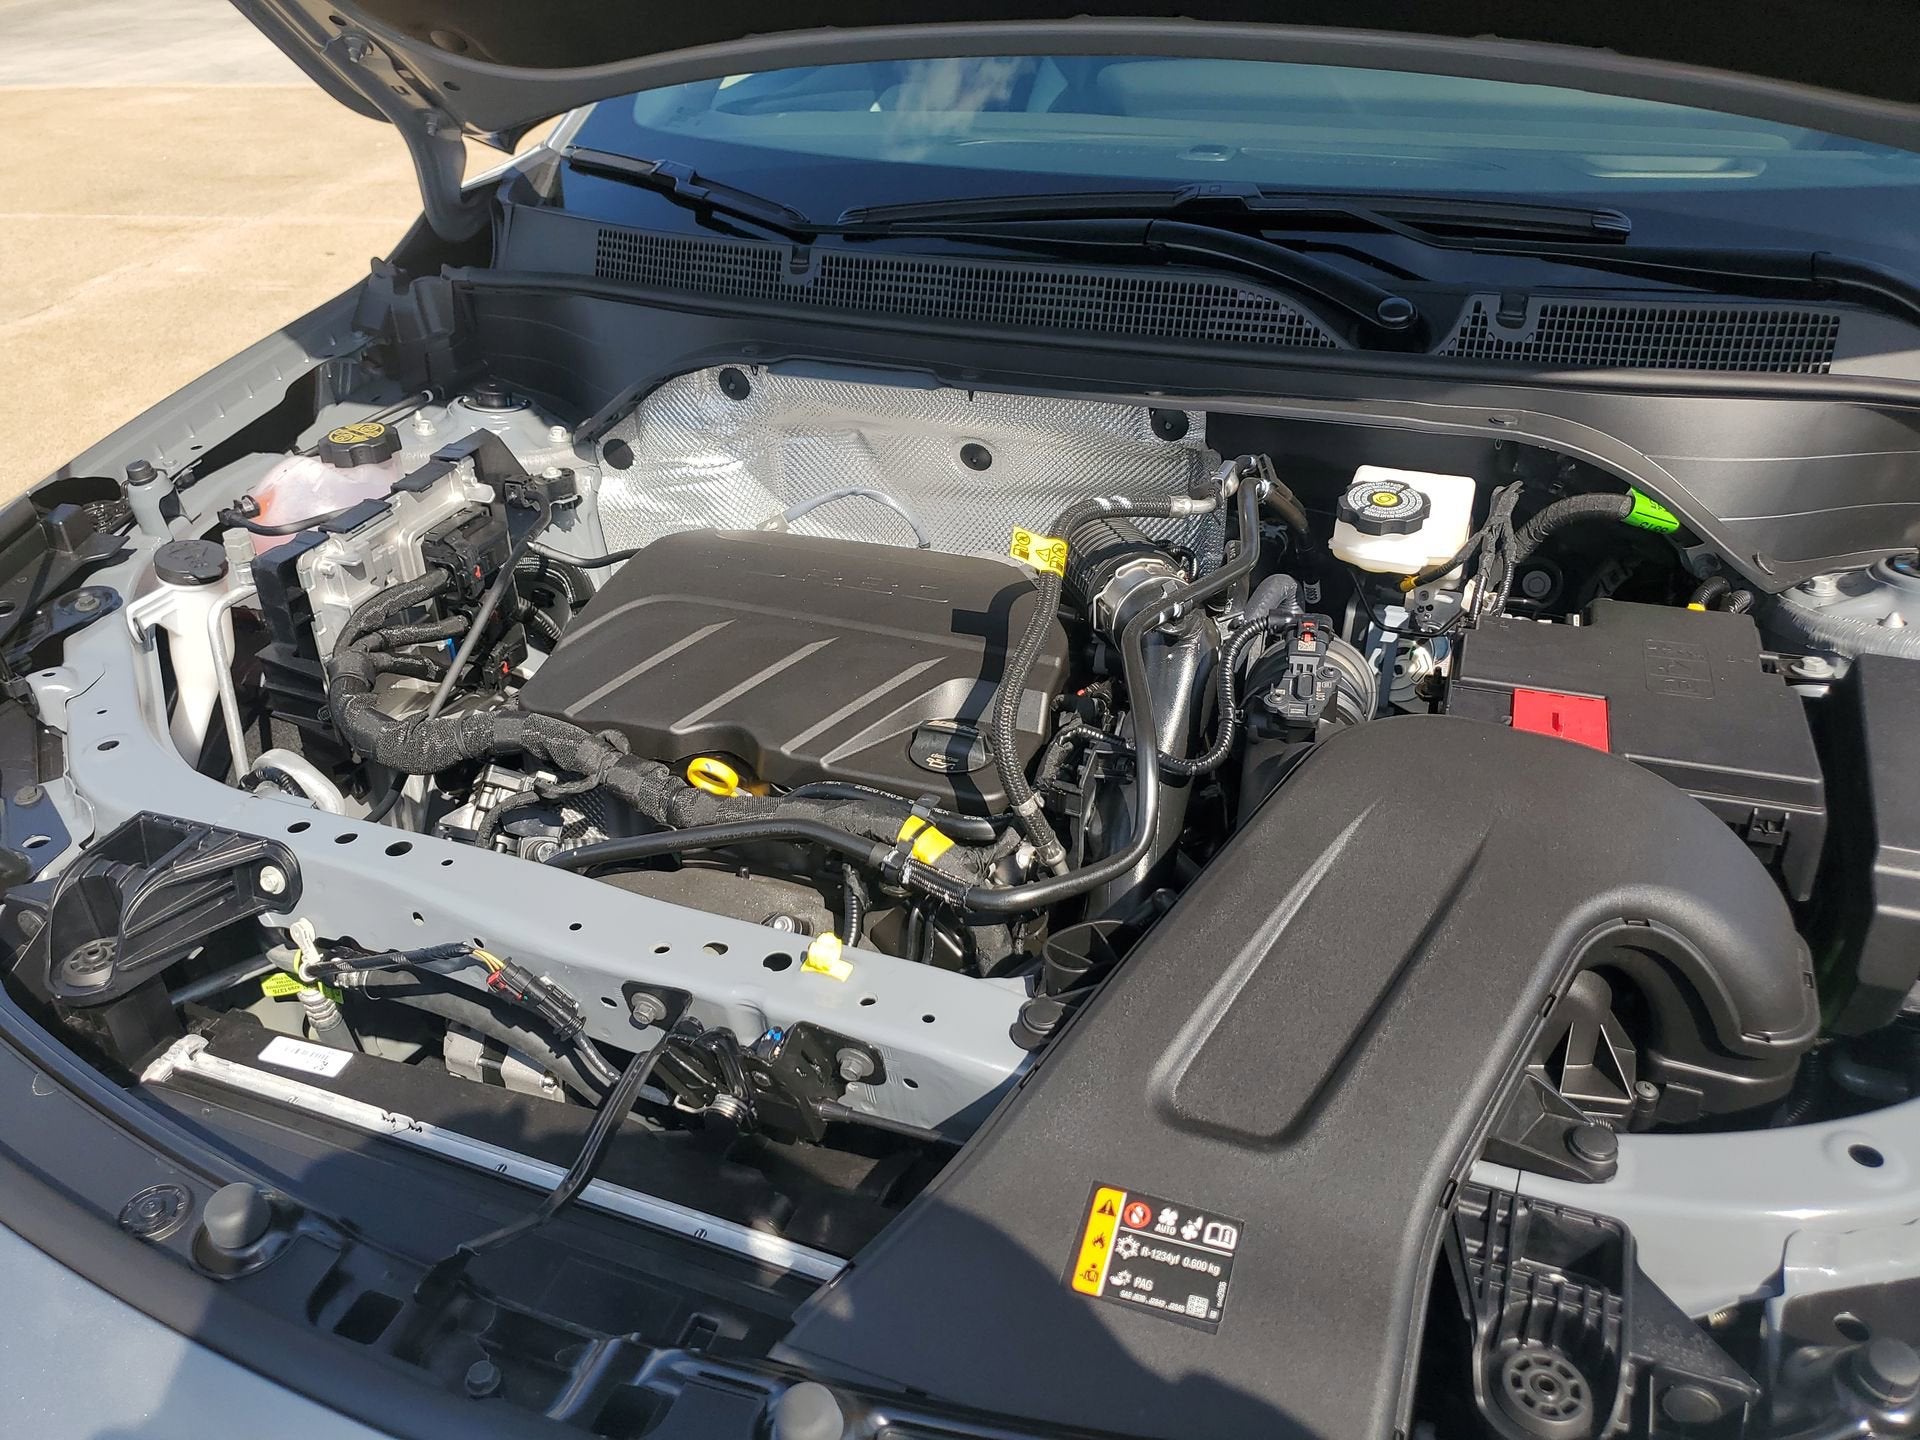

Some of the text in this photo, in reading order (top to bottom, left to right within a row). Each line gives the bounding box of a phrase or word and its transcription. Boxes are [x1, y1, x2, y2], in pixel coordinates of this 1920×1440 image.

[1155, 1225, 1177, 1236] AUTO
[1142, 1248, 1221, 1277] R-1234yf 0.600 kg
[1134, 1277, 1153, 1291] PAG
